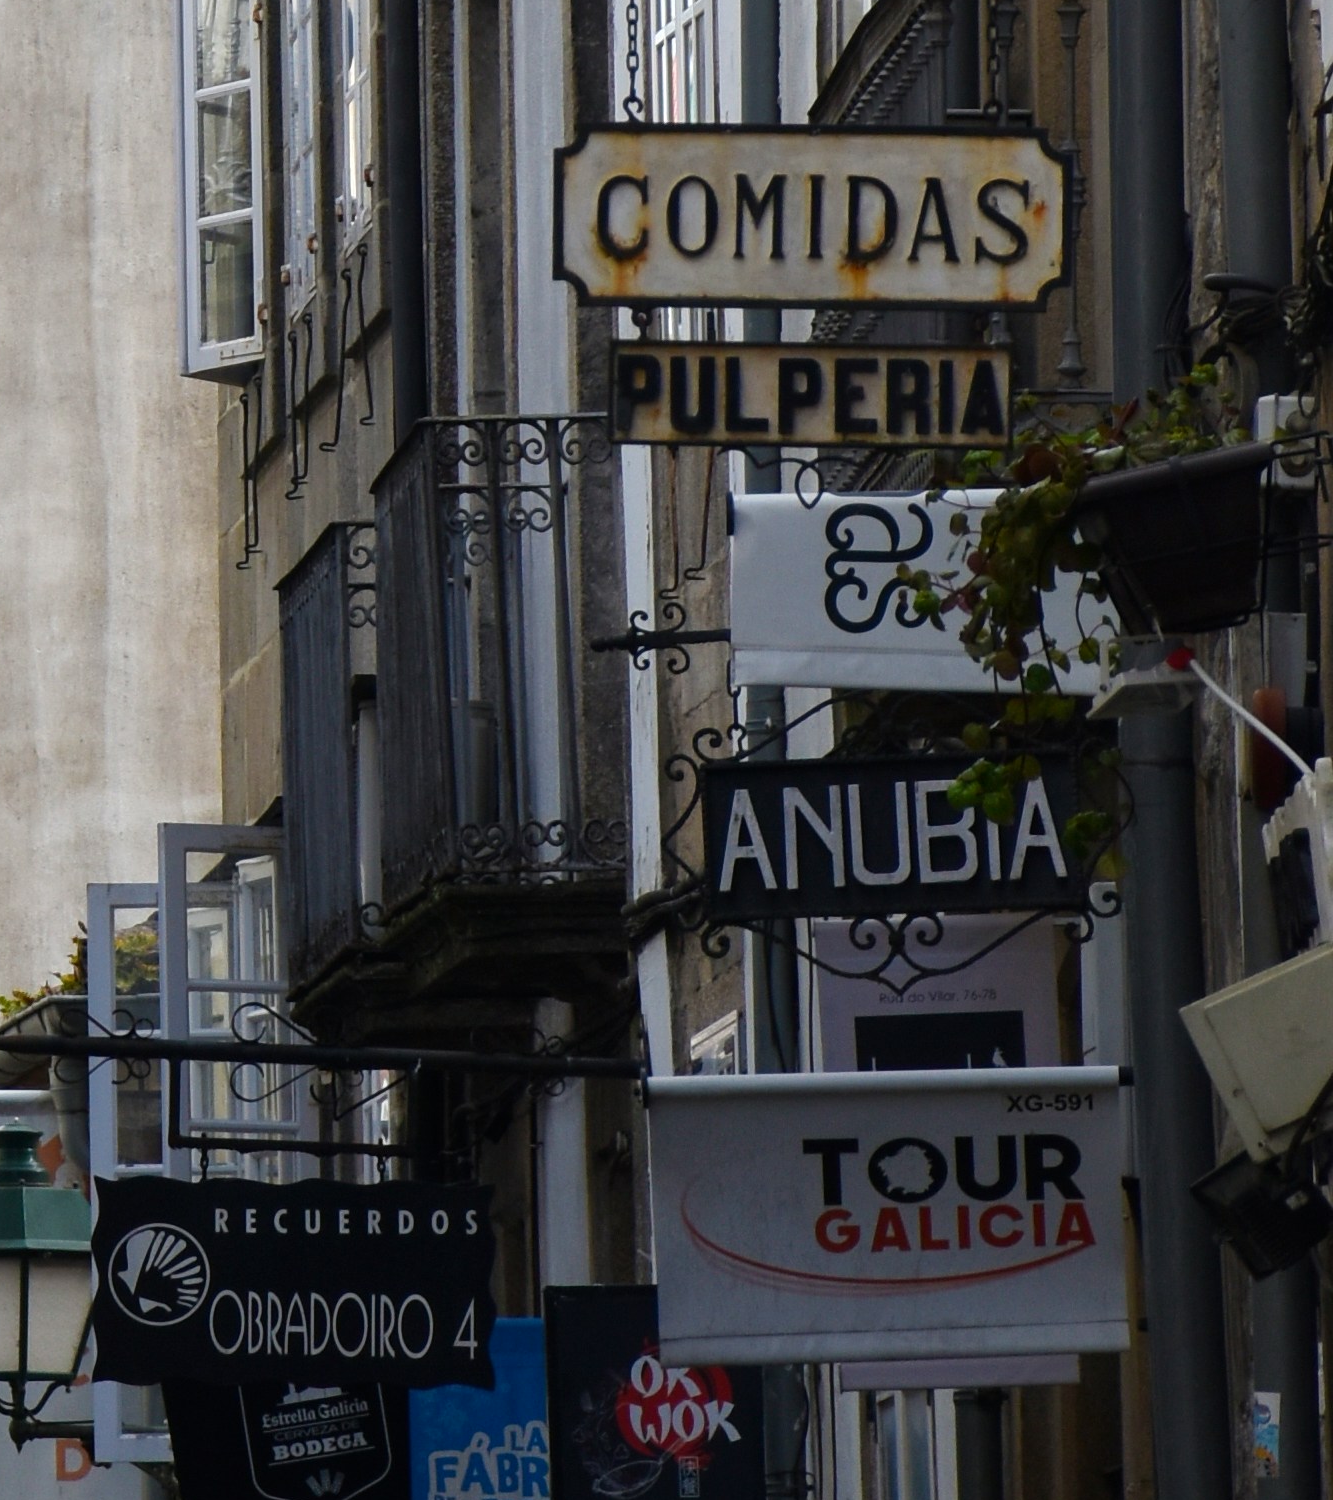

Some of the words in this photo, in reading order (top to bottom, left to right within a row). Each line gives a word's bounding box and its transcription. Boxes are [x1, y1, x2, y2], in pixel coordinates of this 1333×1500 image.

[594, 173, 1034, 266] COMIDAS
[616, 355, 1007, 437] PULPERIA
[719, 777, 1067, 893] ANUBIA
[1007, 1094, 1094, 1112] XG-591
[802, 1133, 1082, 1205] TOUR
[213, 1207, 479, 1236] RECUERDOS
[813, 1203, 1096, 1254] GALICIA
[209, 1290, 434, 1360] OBRADOIRO
[453, 1296, 479, 1360] 4
[630, 1355, 702, 1398] OK
[262, 1408, 317, 1430] Estrella
[317, 1398, 370, 1421] Galicia
[273, 1424, 339, 1442] CERVEZA
[629, 1400, 742, 1444] WOK
[272, 1431, 369, 1461] BODEGA
[511, 1426, 548, 1453] LA
